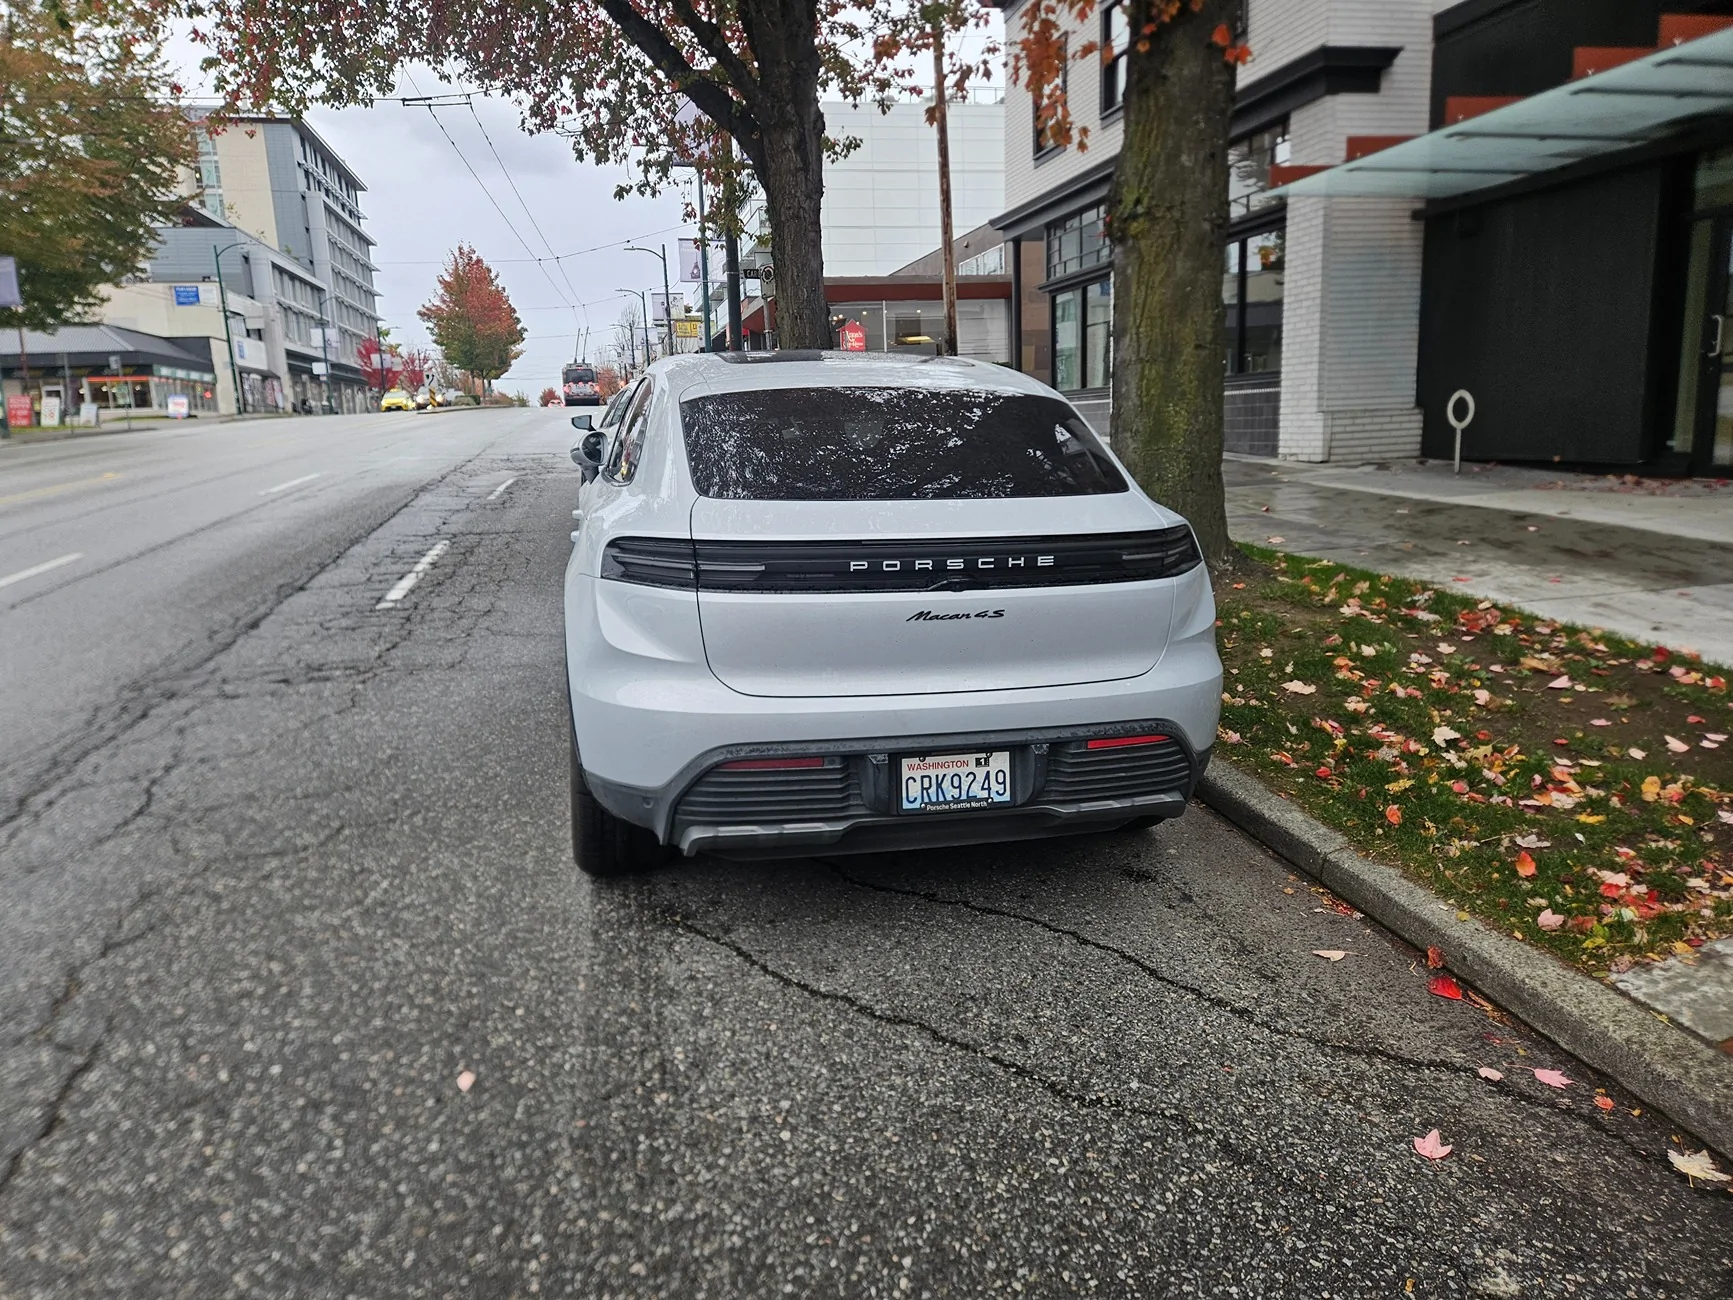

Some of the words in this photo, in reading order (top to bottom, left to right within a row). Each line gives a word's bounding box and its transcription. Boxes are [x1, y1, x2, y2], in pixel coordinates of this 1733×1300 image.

[850, 555, 1055, 572] PORSCHE
[906, 610, 972, 622] Macan
[974, 609, 1005, 619] 4S
[906, 760, 969, 771] WASHINGTON
[905, 769, 1007, 804] CRK9249
